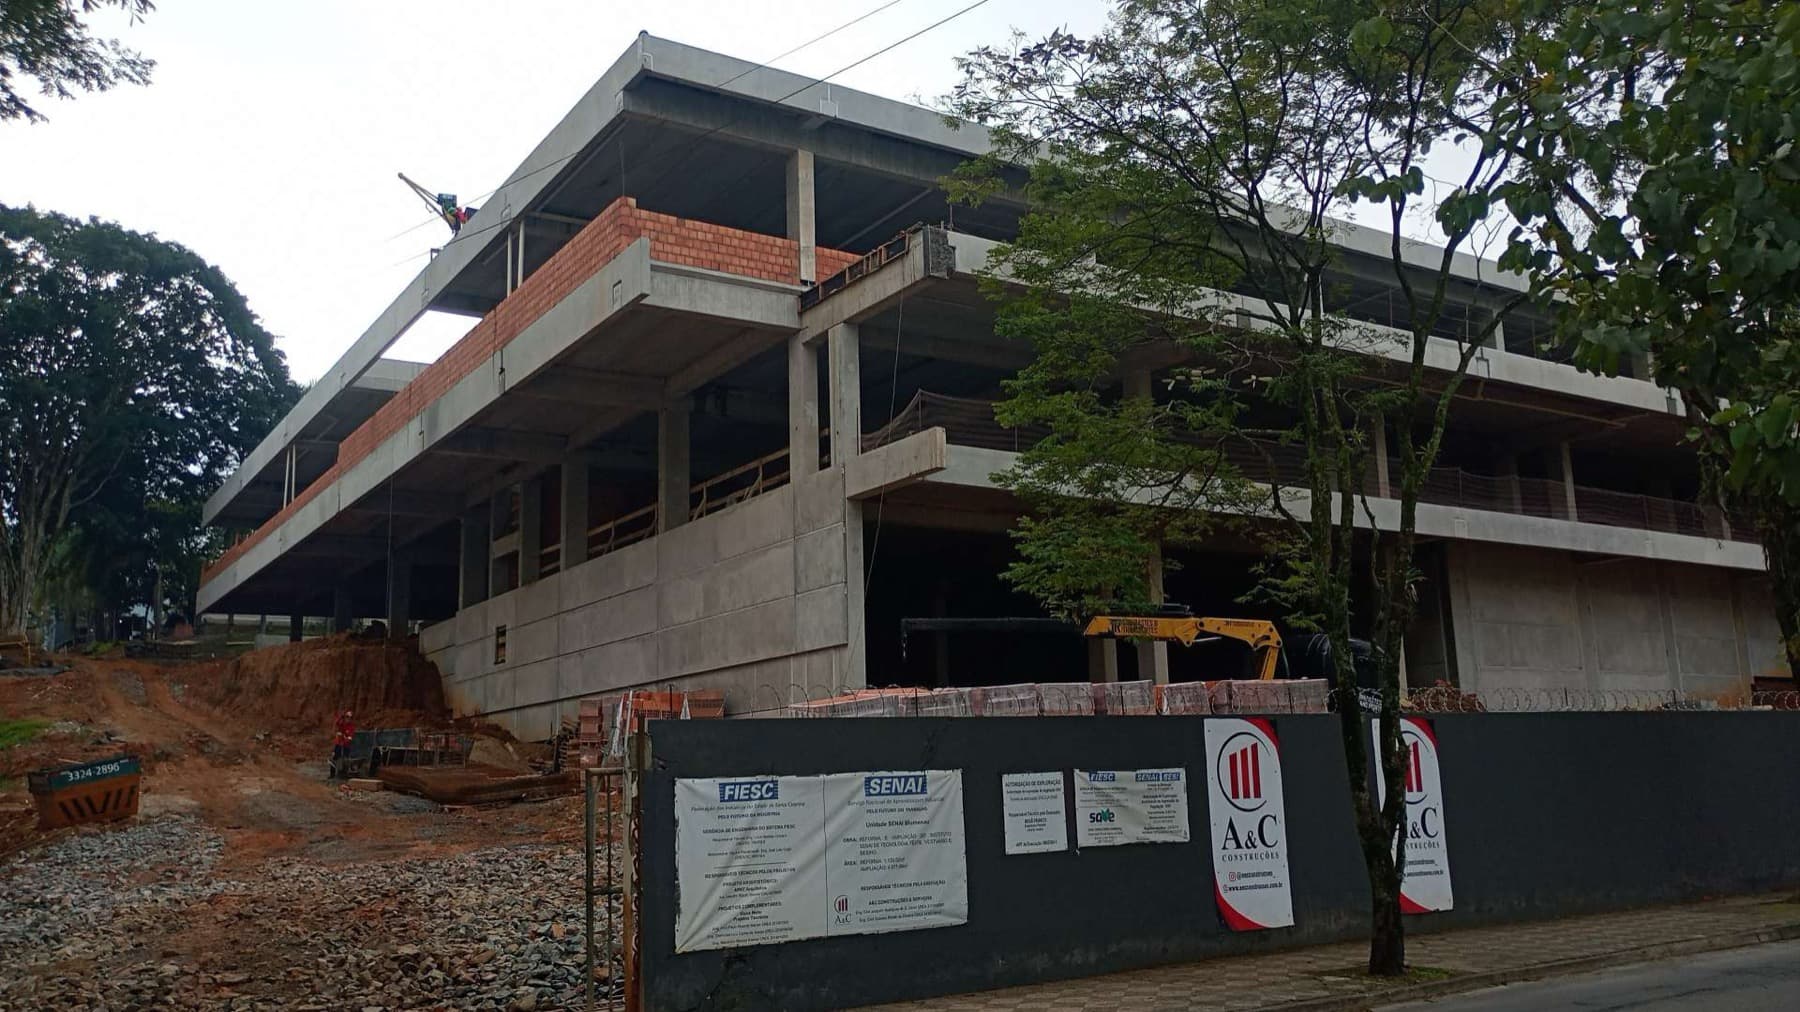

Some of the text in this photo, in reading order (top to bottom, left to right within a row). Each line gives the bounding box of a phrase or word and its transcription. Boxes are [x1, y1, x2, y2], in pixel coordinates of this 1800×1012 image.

[724, 782, 774, 800] FIESC
[869, 777, 923, 794] SENAI
[1221, 814, 1279, 850] A&C
[1221, 850, 1280, 862] CONSTRUÇÕES
